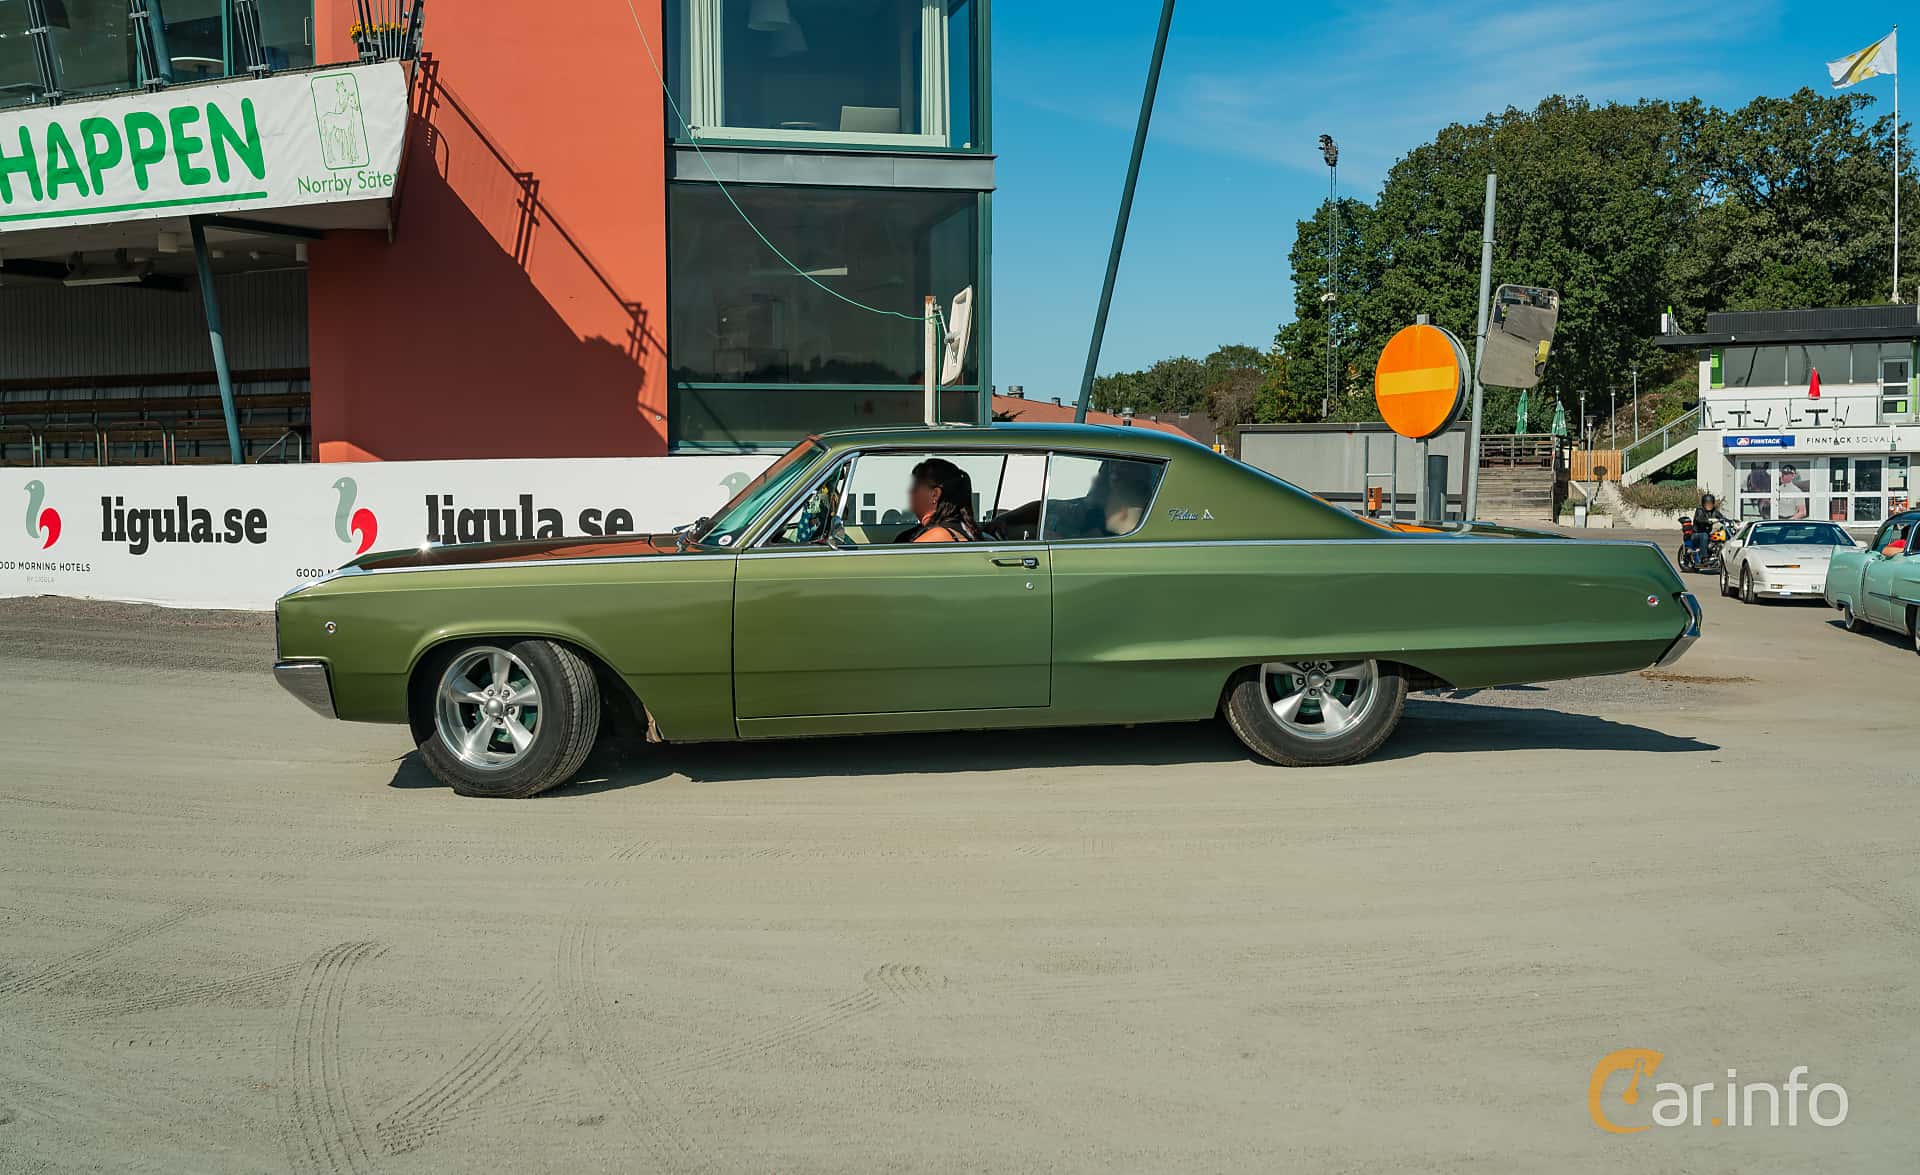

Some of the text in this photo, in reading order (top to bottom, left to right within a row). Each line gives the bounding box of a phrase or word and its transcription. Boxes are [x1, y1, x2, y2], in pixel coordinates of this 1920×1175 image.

[0, 98, 266, 204] HAPPEN
[297, 172, 352, 196] Norrby
[1806, 436, 1852, 445] FINNTCK
[101, 495, 267, 555] ligula.se
[425, 494, 634, 544] ligulase
[18, 561, 57, 571] MORNING
[59, 562, 91, 572] HOTELS
[296, 568, 324, 577] GOOD
